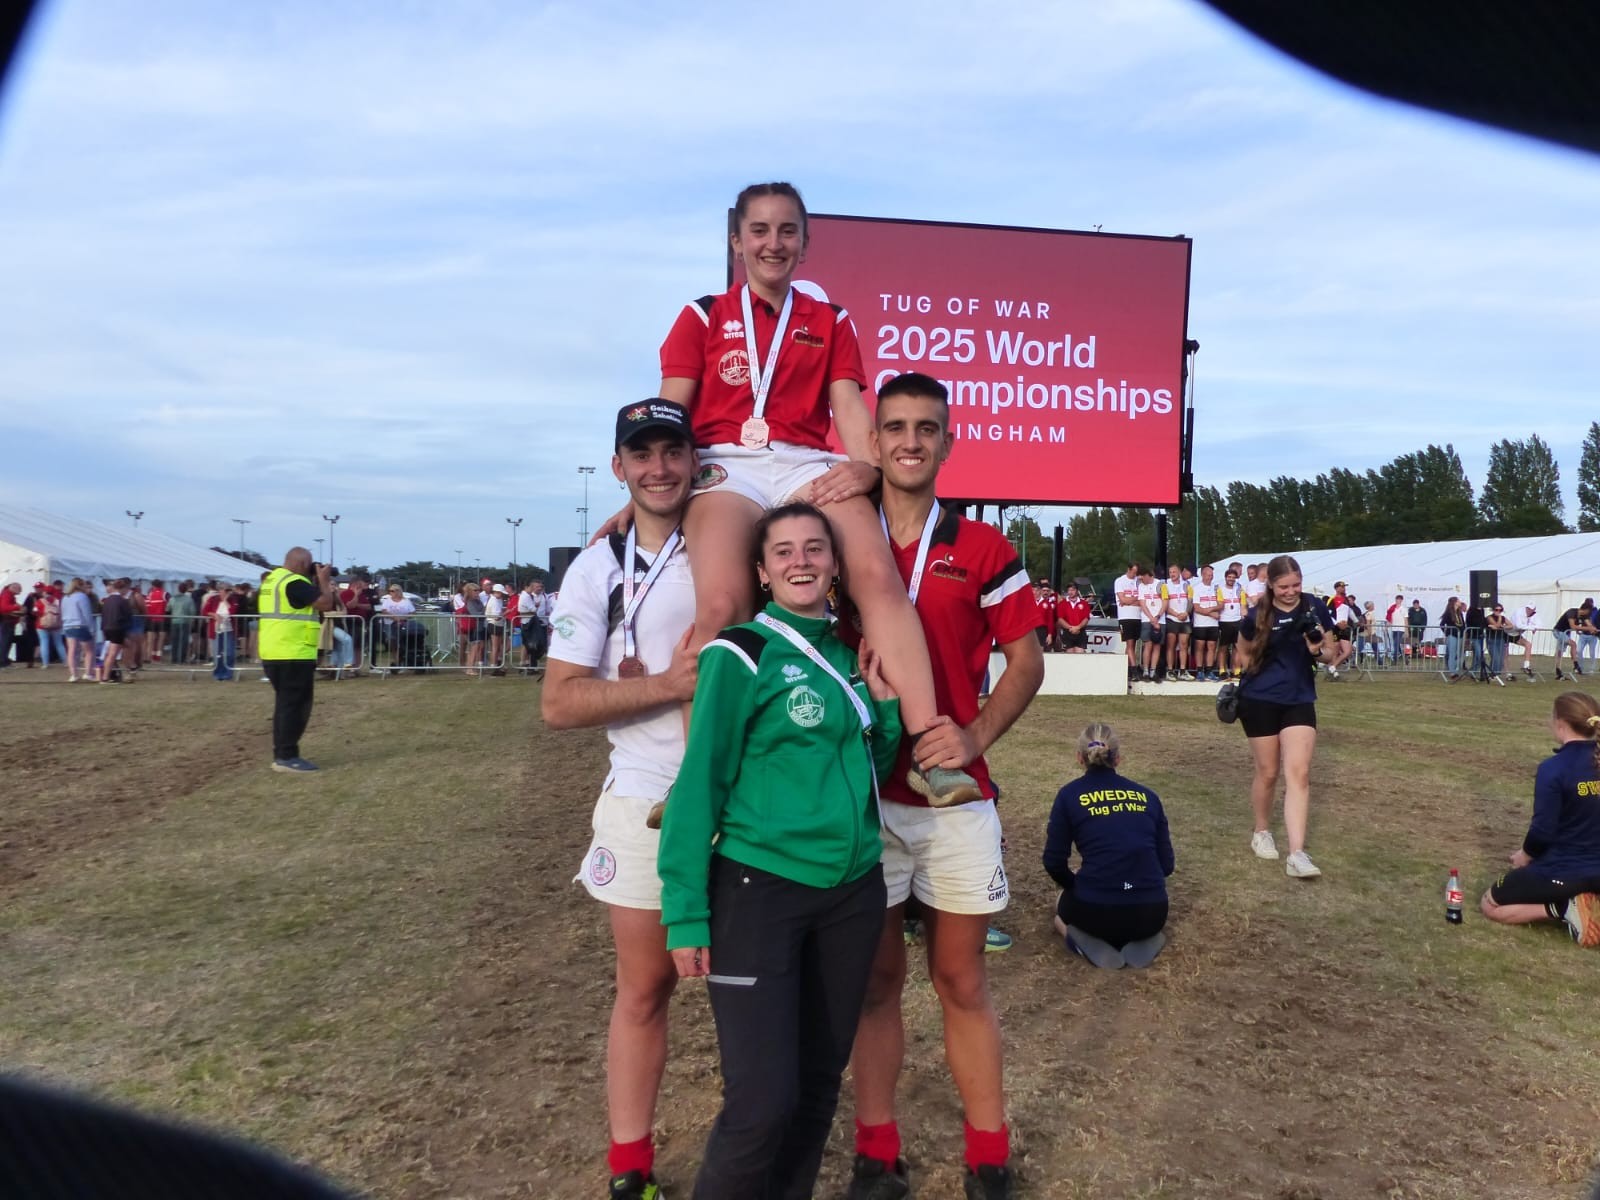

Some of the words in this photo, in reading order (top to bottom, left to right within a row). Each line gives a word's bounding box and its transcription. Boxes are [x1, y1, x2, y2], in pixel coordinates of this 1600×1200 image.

[880, 294, 931, 313] TUG
[947, 297, 980, 315] OF
[995, 300, 1050, 319] WAR
[877, 325, 976, 363] 2025
[985, 330, 1096, 368] World
[874, 369, 1173, 420] Campionships
[1079, 790, 1148, 806] SWEDEN
[1088, 806, 1110, 816] Tug
[1112, 803, 1123, 812] of
[1125, 803, 1146, 812] War
[988, 888, 1007, 901] GMH
